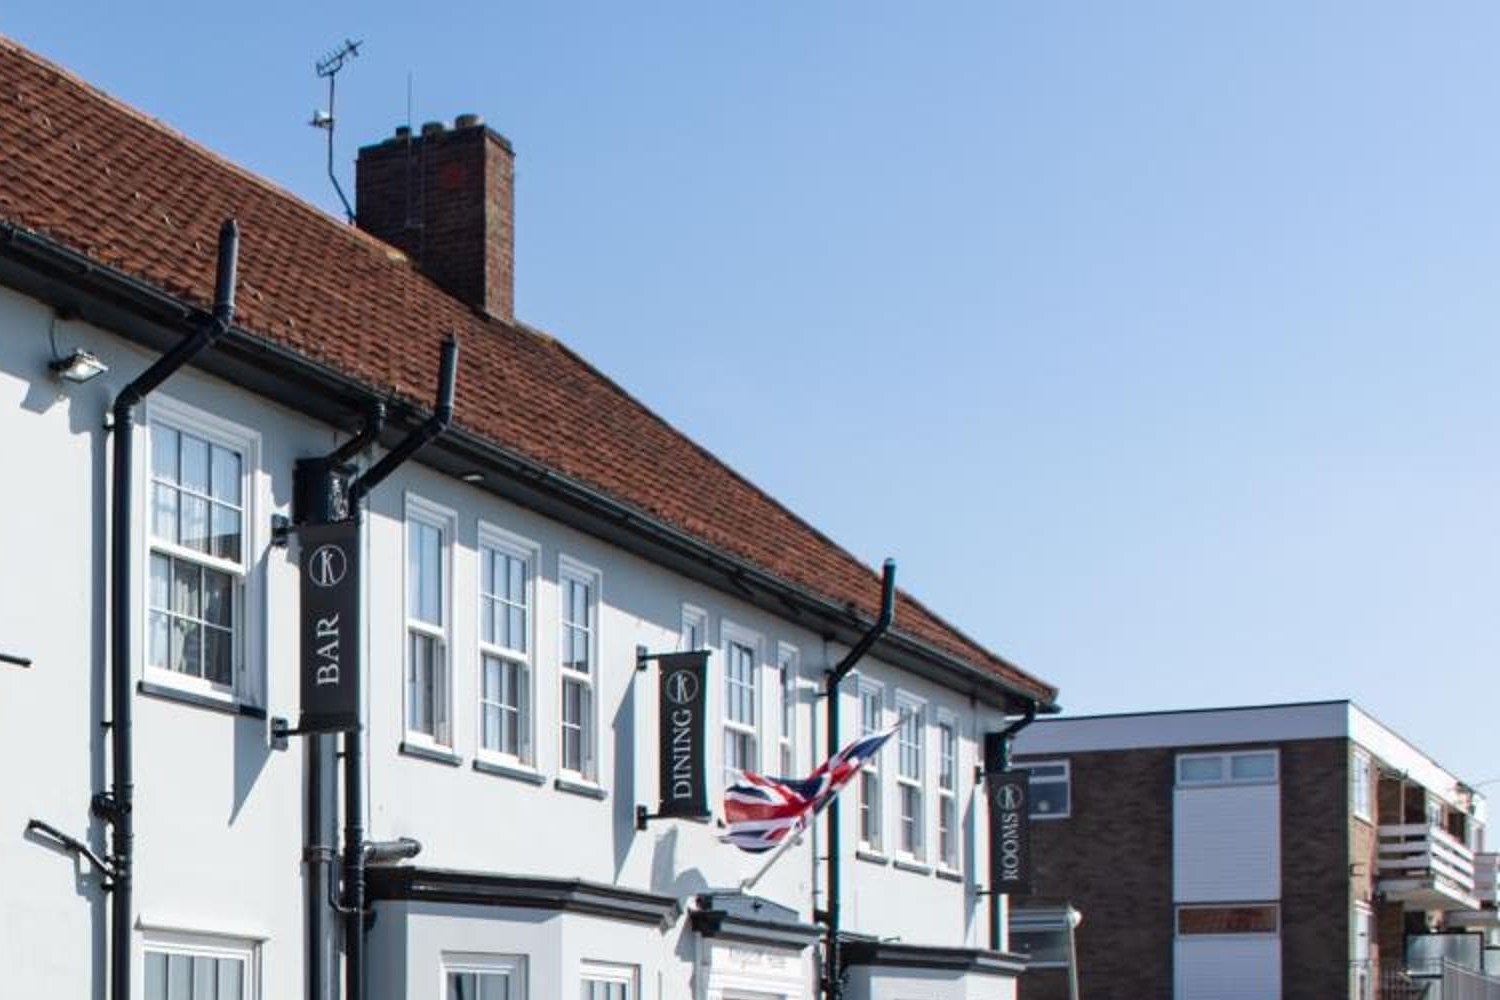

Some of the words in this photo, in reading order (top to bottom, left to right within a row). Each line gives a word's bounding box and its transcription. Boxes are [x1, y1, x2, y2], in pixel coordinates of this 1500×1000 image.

[317, 612, 340, 684] BAR
[672, 708, 692, 799] DINING
[1002, 813, 1019, 880] ROOMS
